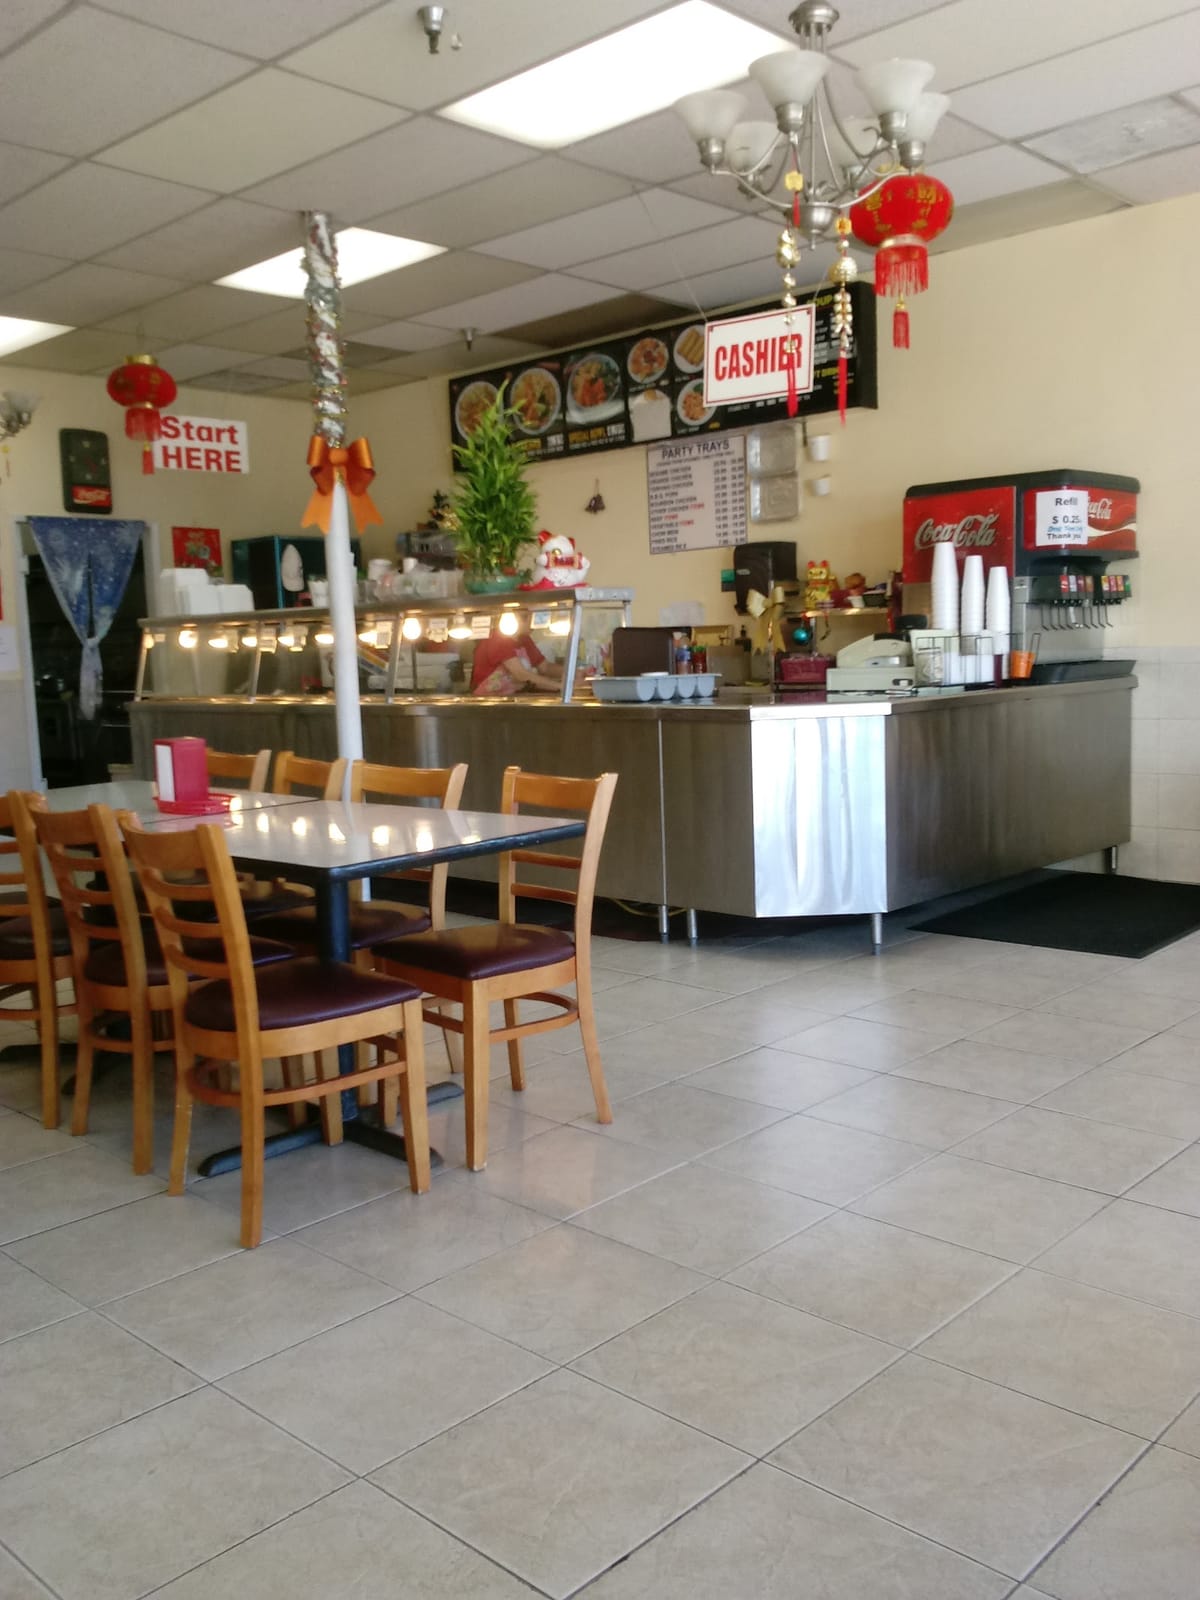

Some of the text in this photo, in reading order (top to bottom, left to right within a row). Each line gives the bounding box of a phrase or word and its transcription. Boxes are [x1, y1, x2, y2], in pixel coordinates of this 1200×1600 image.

[715, 334, 802, 382] CASHIER
[160, 416, 239, 445] Start
[162, 445, 242, 473] HERE
[662, 446, 693, 459] PARTY
[696, 439, 730, 454] TRAYS
[1055, 497, 1078, 506] Refill
[1052, 515, 1059, 524] $
